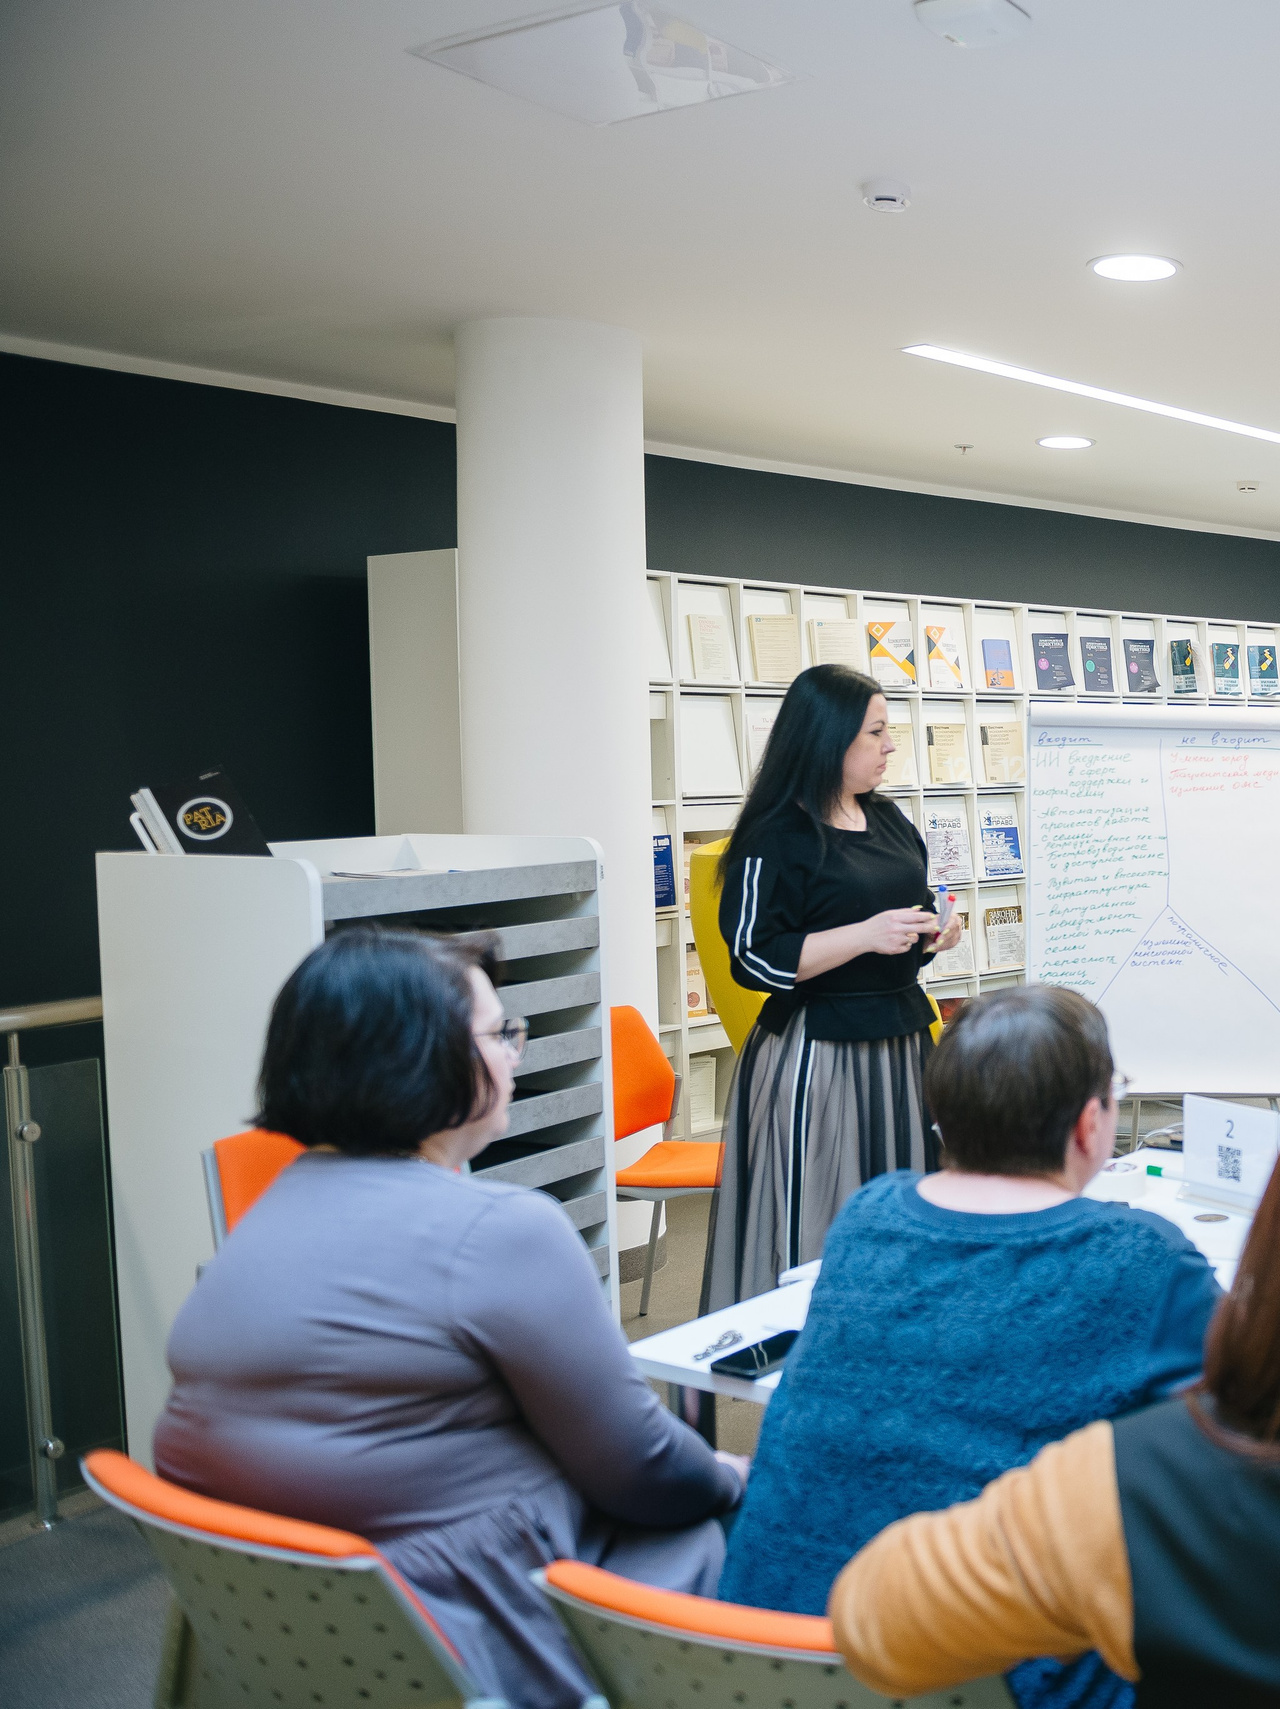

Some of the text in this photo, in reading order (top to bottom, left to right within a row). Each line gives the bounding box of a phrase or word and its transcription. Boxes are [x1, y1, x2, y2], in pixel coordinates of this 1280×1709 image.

[1038, 731, 1092, 749] входит
[1182, 731, 1271, 750] не входит
[1225, 1119, 1235, 1139] 2
